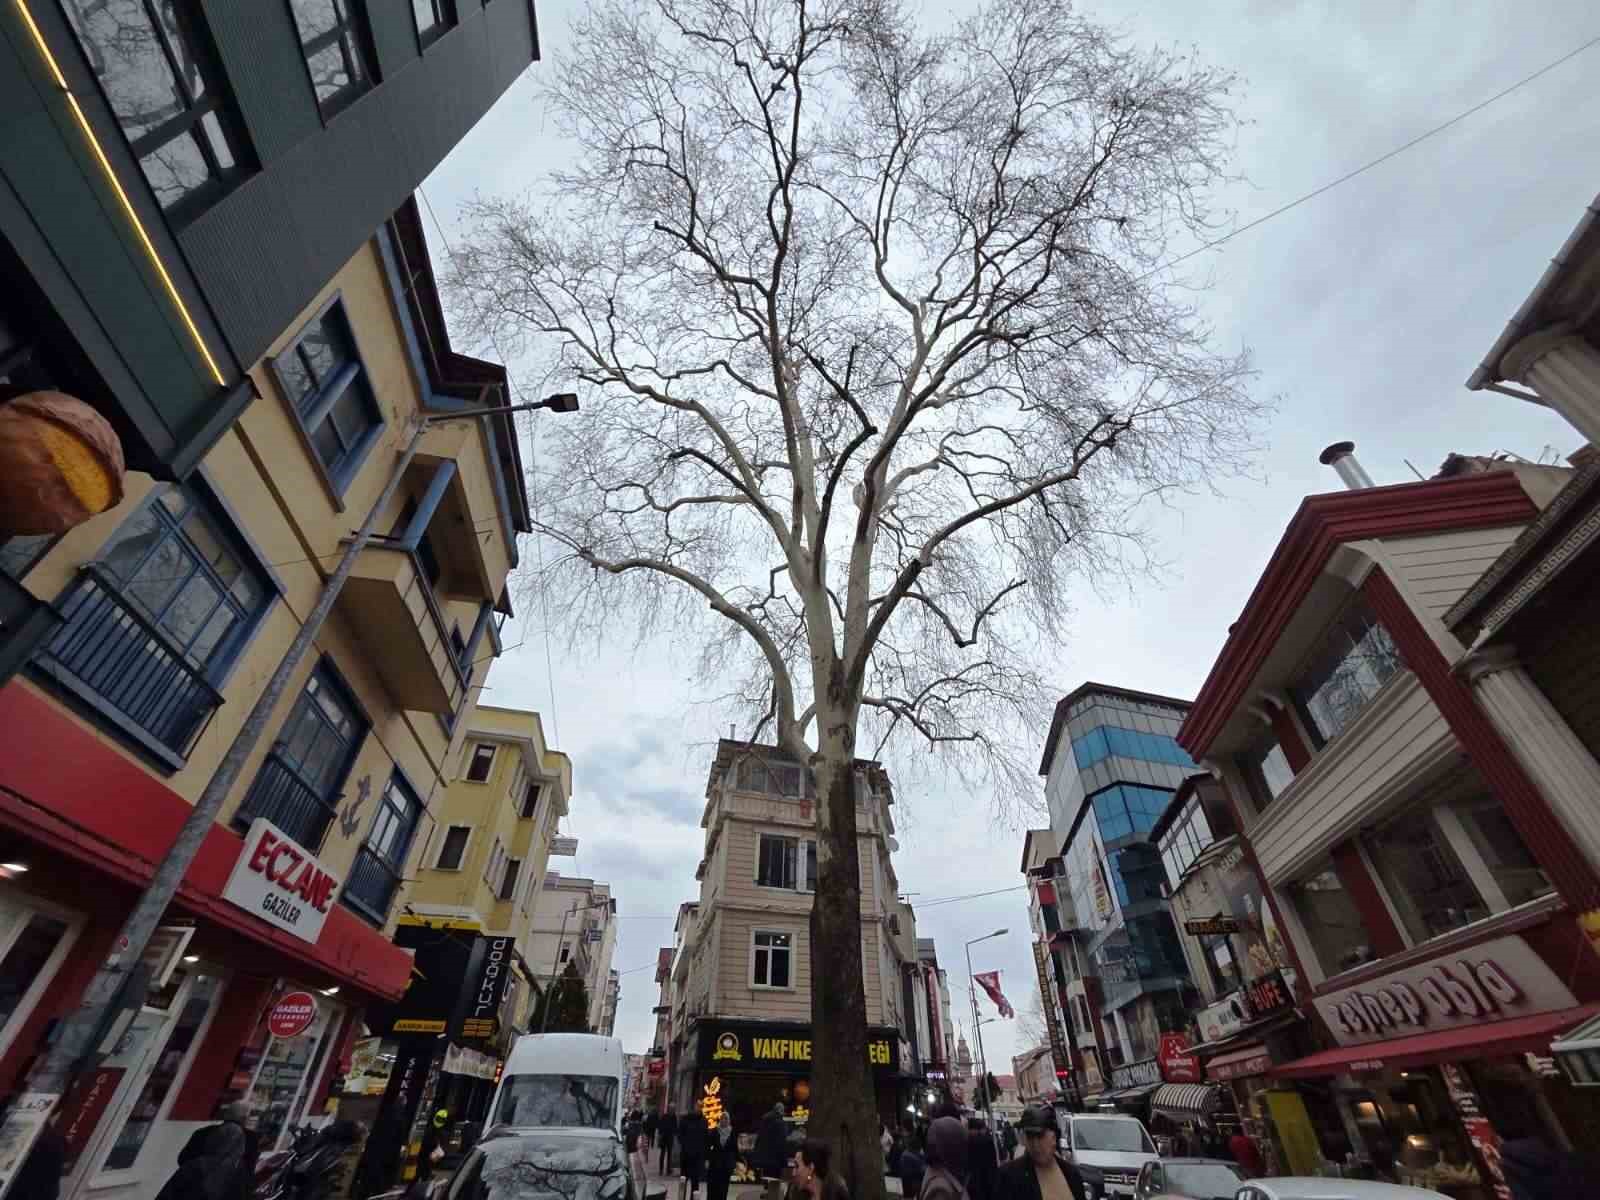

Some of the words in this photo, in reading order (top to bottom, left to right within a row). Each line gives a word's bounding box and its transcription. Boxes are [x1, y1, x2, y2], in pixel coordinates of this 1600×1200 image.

[248, 828, 338, 914] ECZANE
[262, 892, 301, 926] GAZİLER
[753, 1038, 812, 1060] VAKFIKE
[868, 1040, 891, 1064] EĞİ
